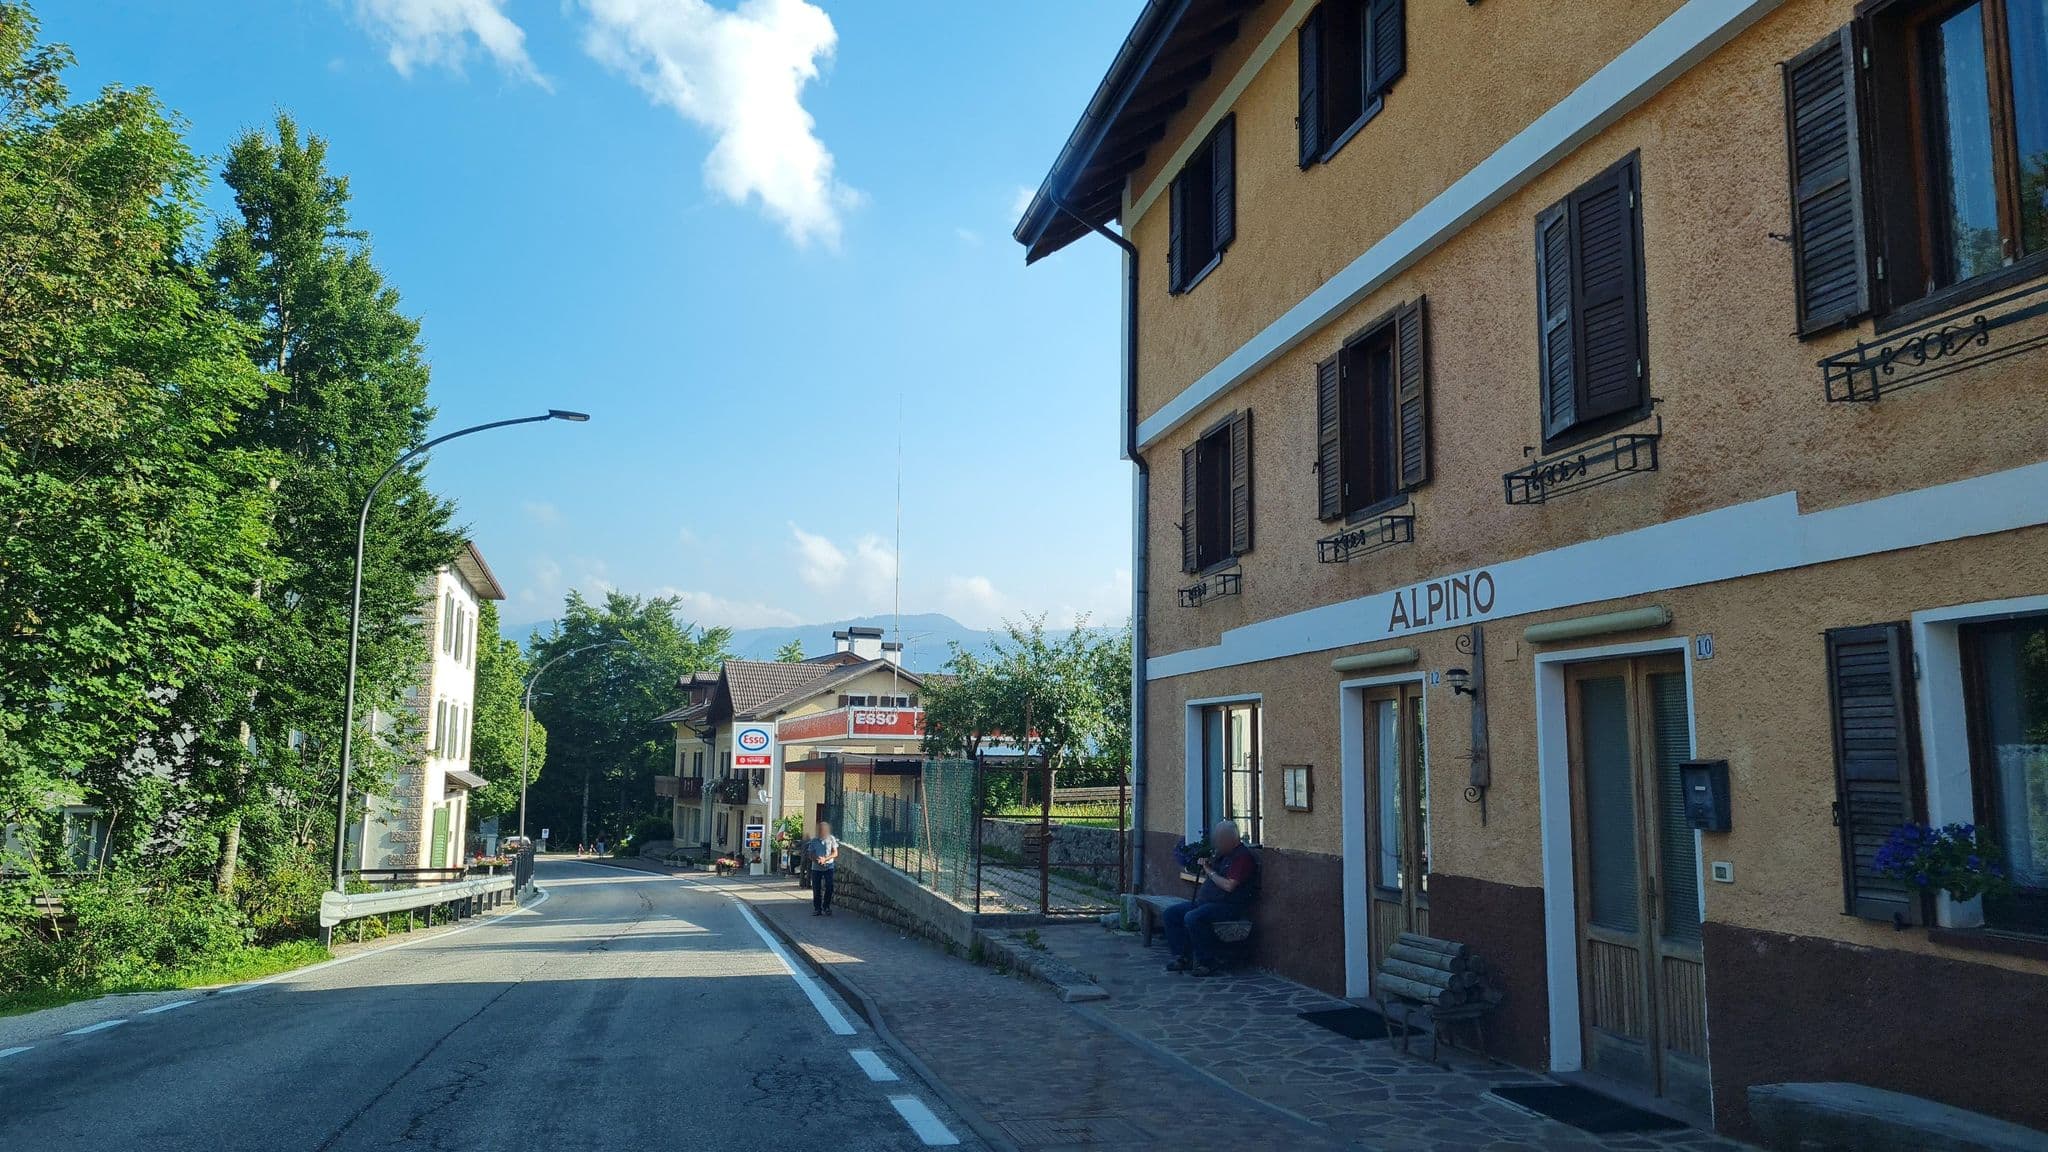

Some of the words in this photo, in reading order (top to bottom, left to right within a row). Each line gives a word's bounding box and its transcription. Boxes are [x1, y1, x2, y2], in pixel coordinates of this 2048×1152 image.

[1388, 571, 1495, 632] ALPINO
[1697, 638, 1711, 655] 10
[1431, 671, 1440, 684] 12
[855, 713, 898, 725] ESSO
[743, 735, 765, 744] Esso
